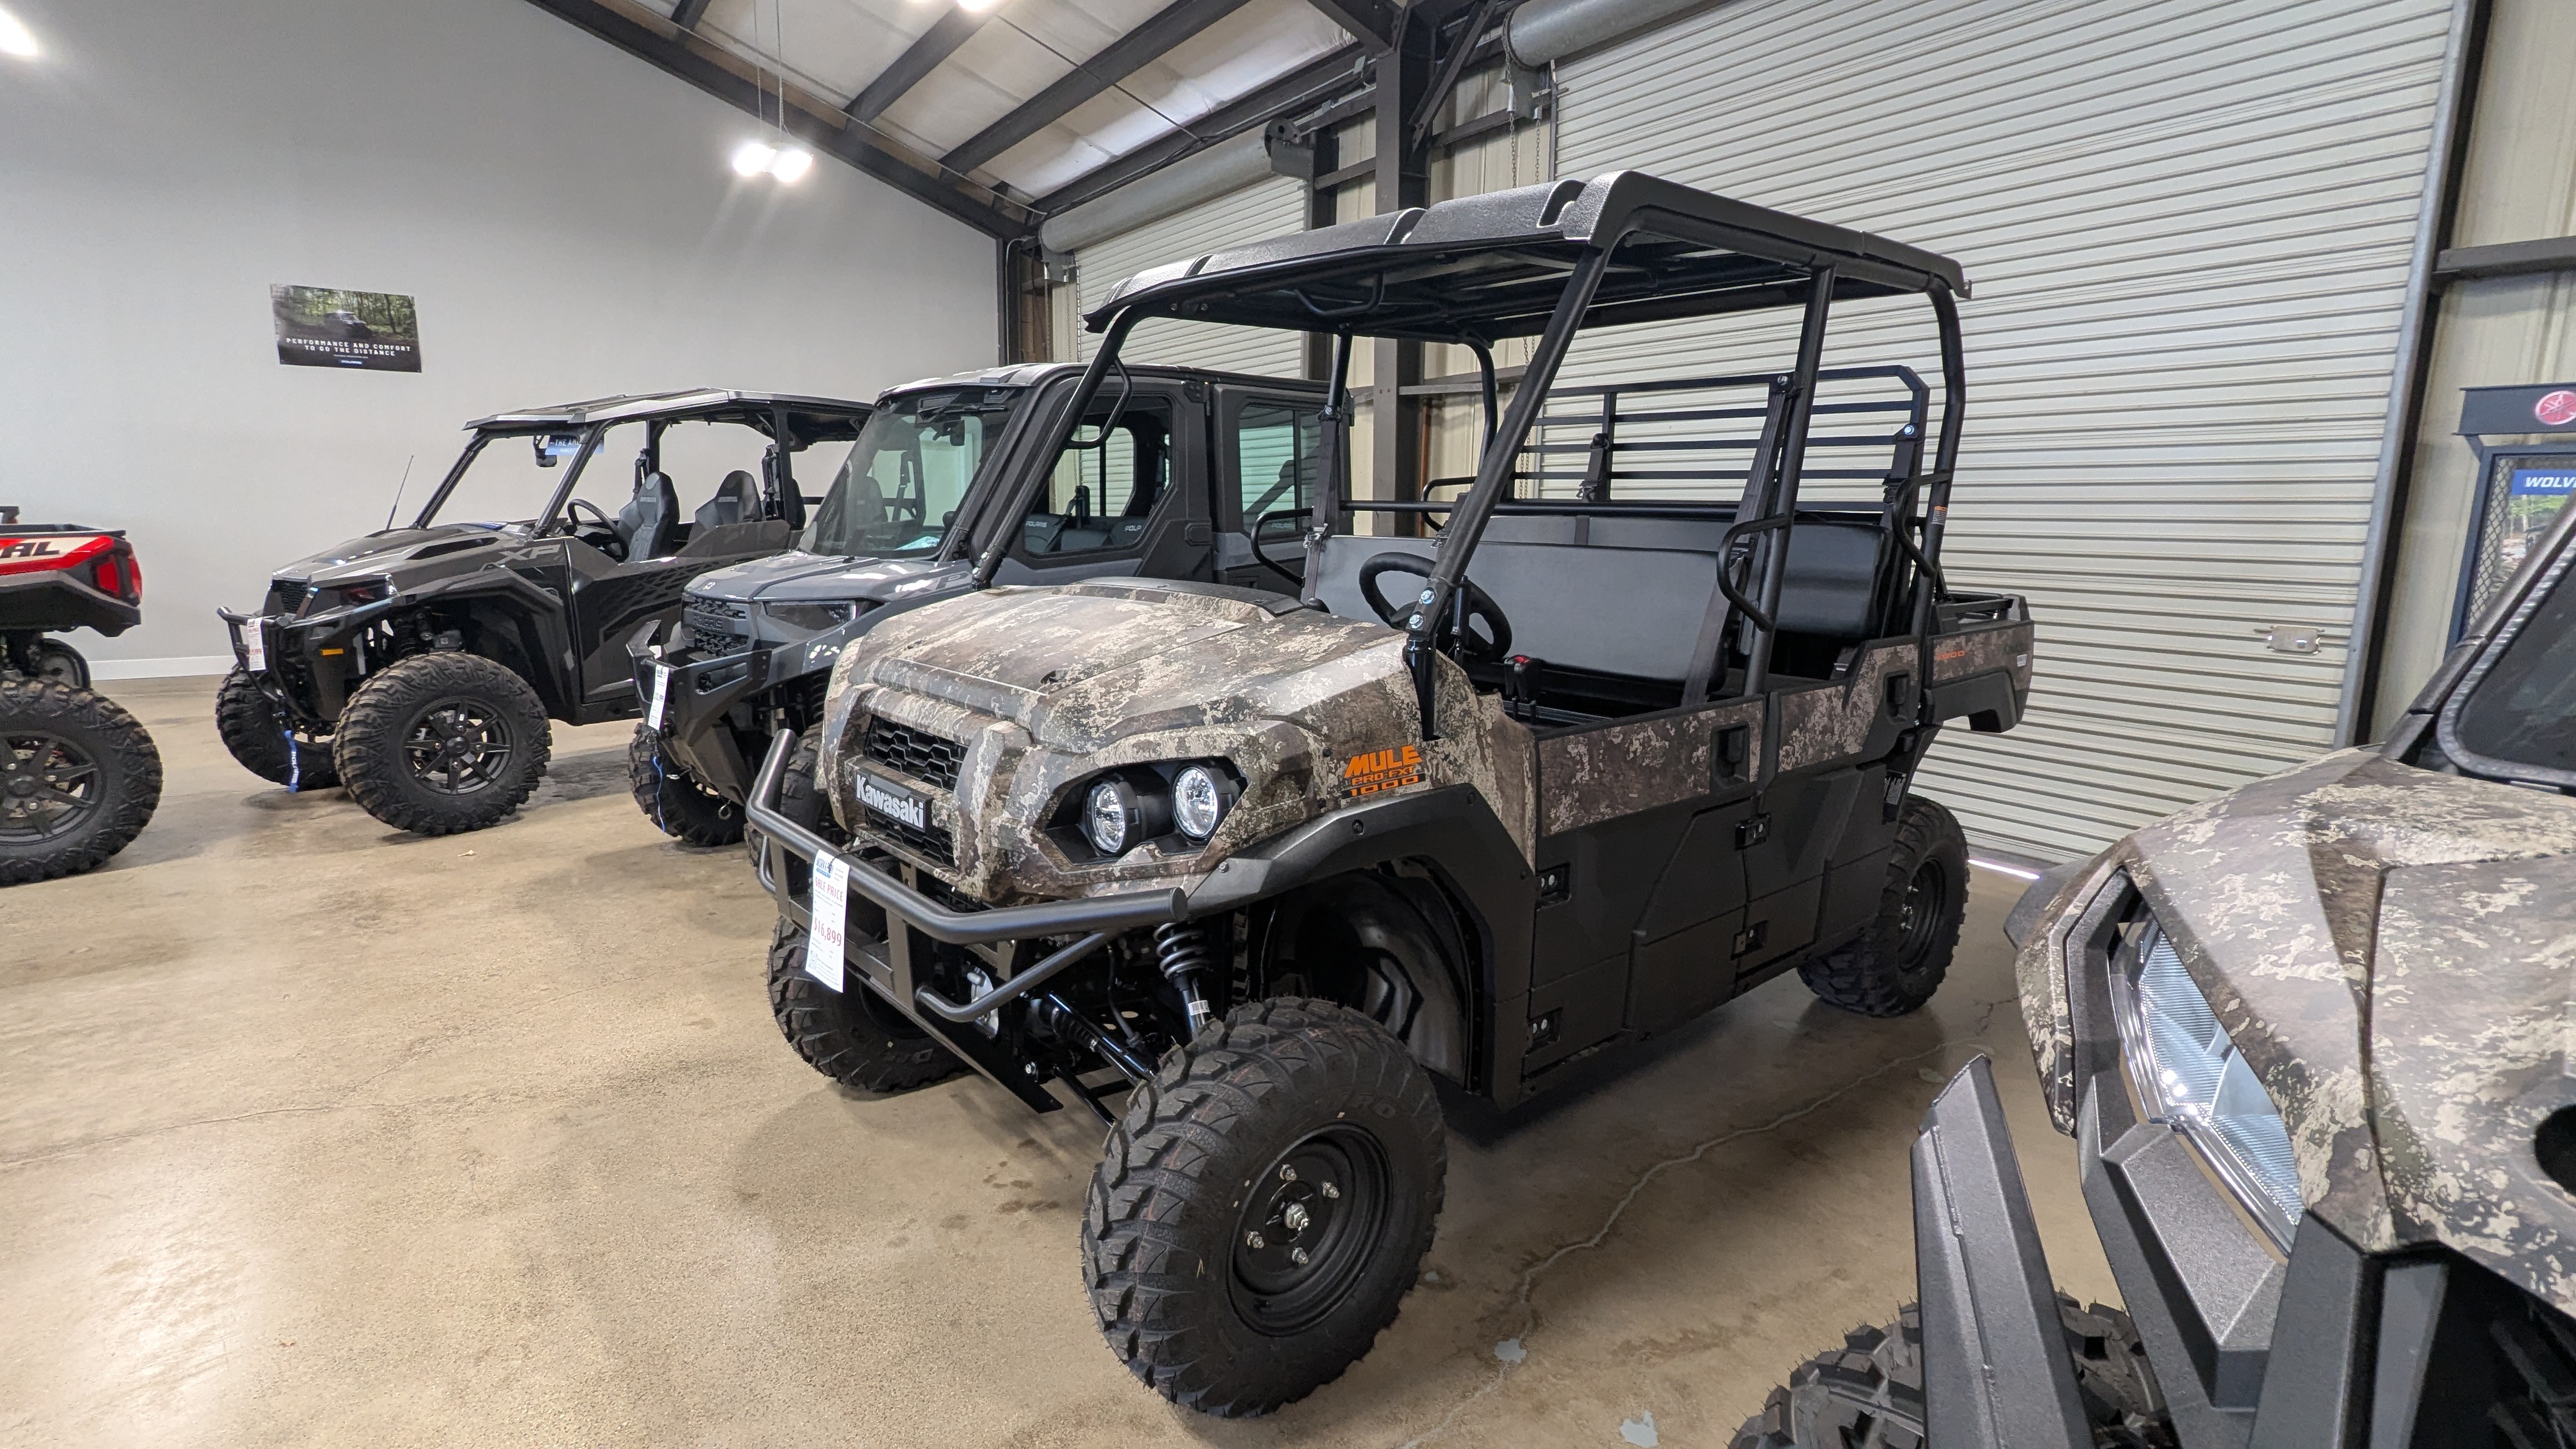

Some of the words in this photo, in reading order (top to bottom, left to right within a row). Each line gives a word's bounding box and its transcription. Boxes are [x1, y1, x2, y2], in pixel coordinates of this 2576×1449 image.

[286, 338, 349, 348] PERFORMANCE
[496, 544, 561, 565] XP
[1344, 744, 1422, 778] MULE
[1350, 774, 1419, 797] 1000
[856, 774, 924, 829] Kawasaki
[815, 877, 825, 892] SALE
[827, 884, 844, 901] PRICE
[814, 917, 842, 947] $16,899
